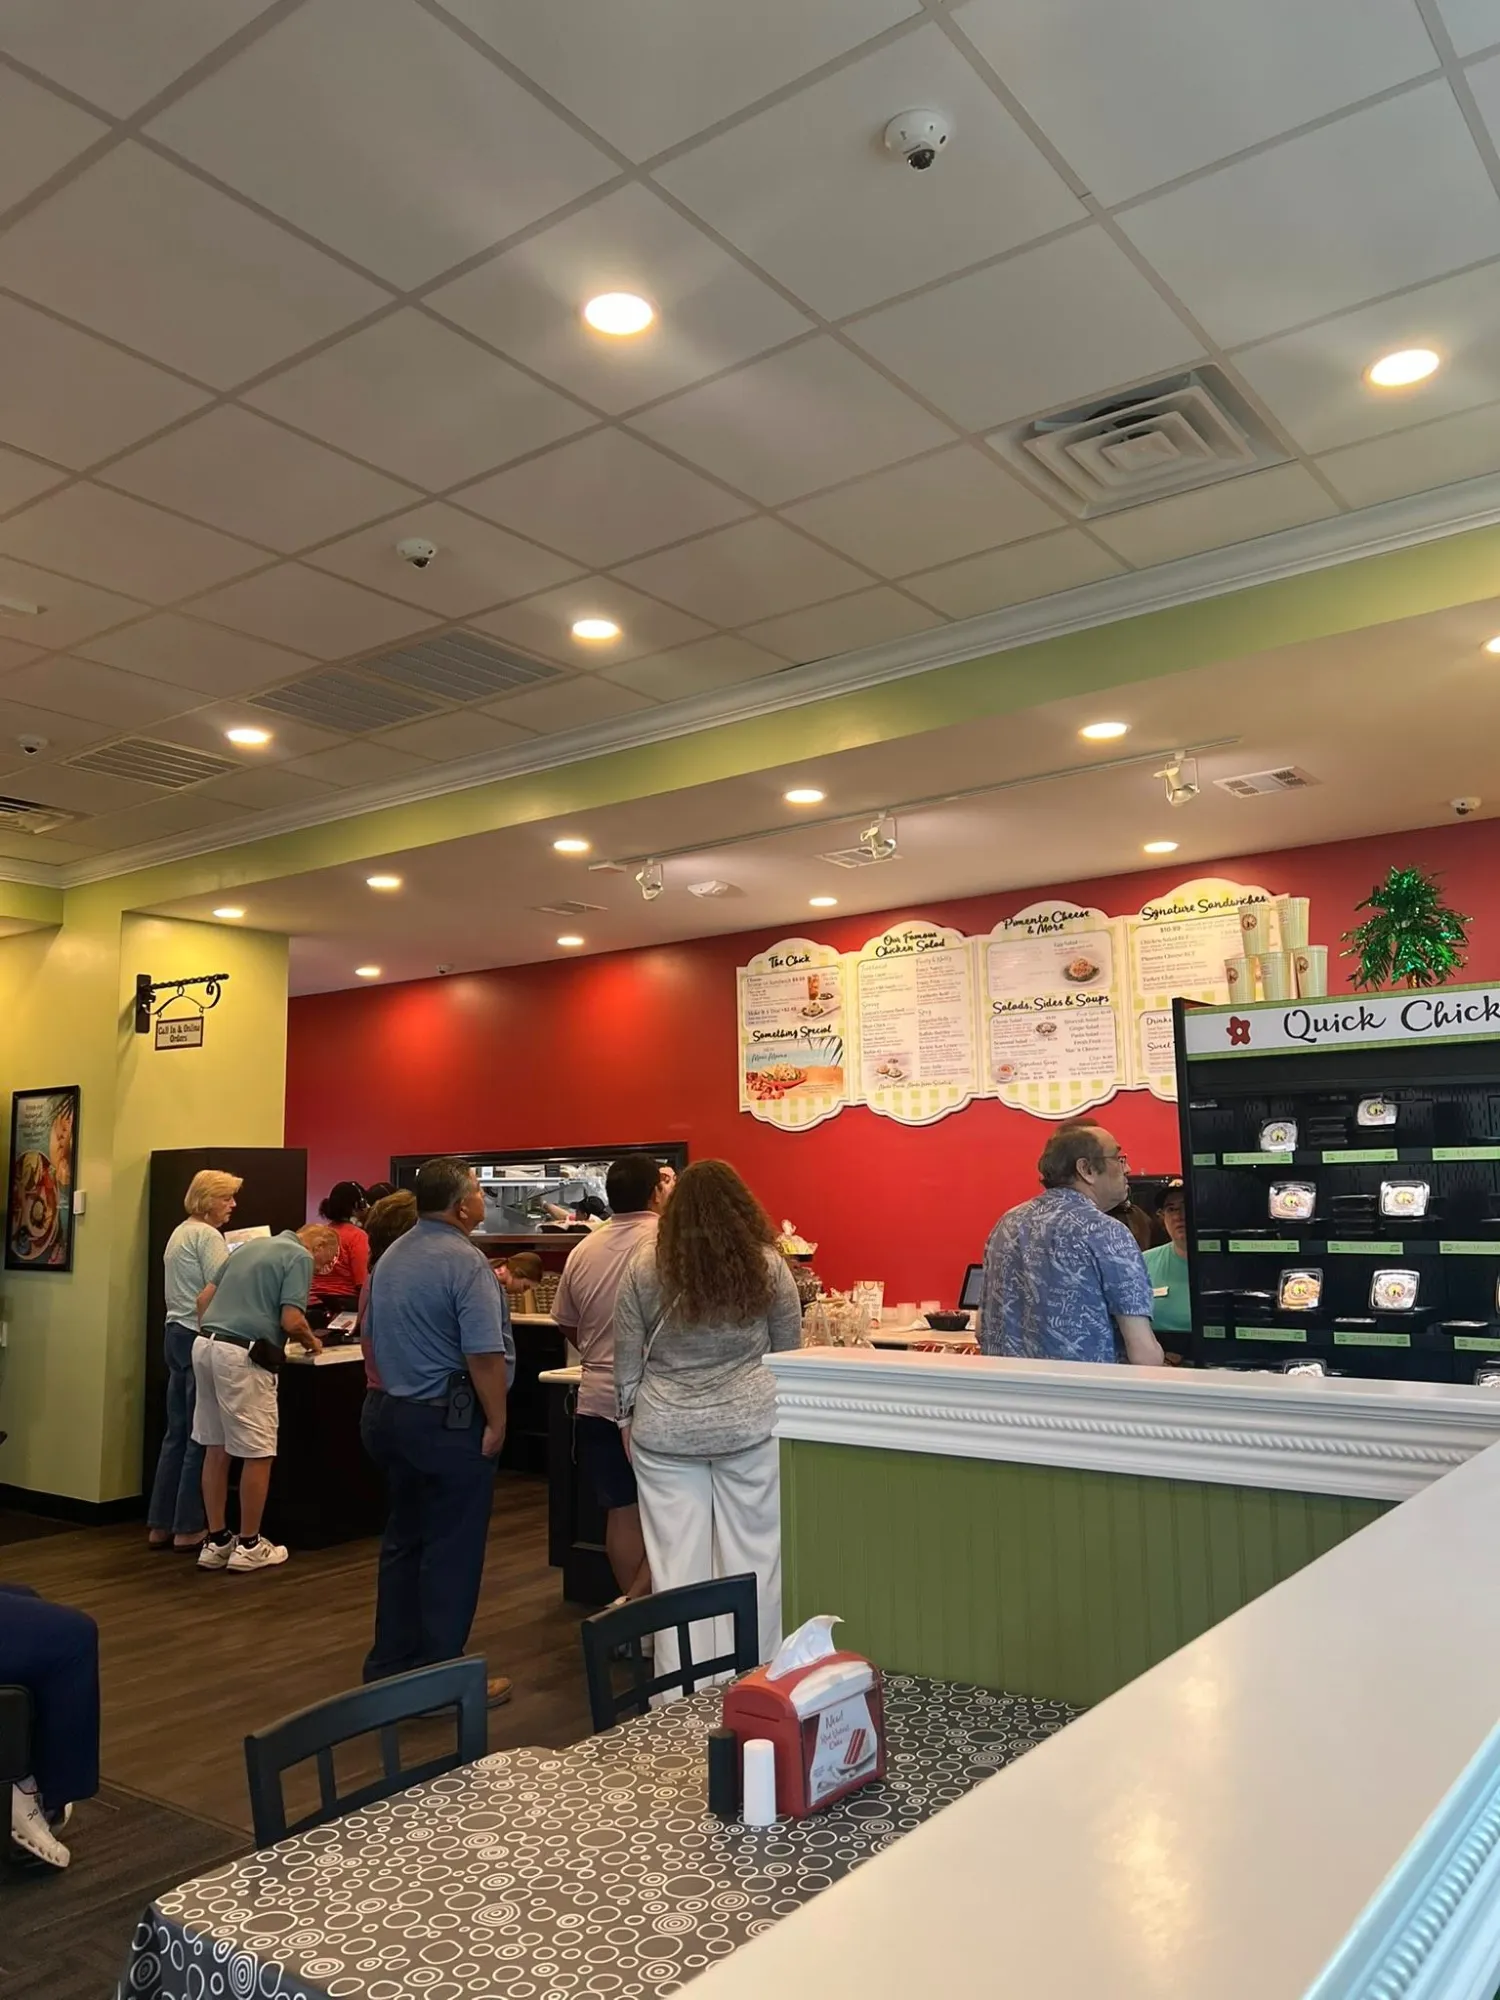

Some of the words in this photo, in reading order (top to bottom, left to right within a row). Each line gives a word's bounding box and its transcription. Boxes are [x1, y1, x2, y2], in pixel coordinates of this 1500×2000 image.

[1141, 903, 1196, 921] Signature
[1197, 894, 1267, 914] Sandwiches
[1003, 914, 1049, 930] Pimento
[1051, 910, 1090, 923] Cheese
[1027, 925, 1035, 934] &
[1036, 923, 1065, 935] More
[883, 934, 901, 946] Our
[903, 930, 937, 943] Famous
[875, 945, 914, 958] Chicken
[916, 938, 945, 952] Salad
[768, 955, 784, 968] The
[786, 954, 811, 967] Chick
[992, 1000, 1033, 1014] Salads,
[1033, 997, 1063, 1011] Sides
[1065, 996, 1074, 1006] &
[1075, 993, 1110, 1007] Soups
[1146, 1015, 1172, 1026] Drinks
[1283, 1006, 1387, 1043] Quick
[1400, 995, 1500, 1032] Chick
[158, 1025, 169, 1035] Call
[170, 1025, 176, 1034] In
[177, 1024, 182, 1033] &
[183, 1023, 200, 1032] Online
[752, 1028, 798, 1042] Something
[800, 1024, 832, 1038] Special
[170, 1034, 188, 1043] Orders
[1147, 1041, 1172, 1052] Sweet
